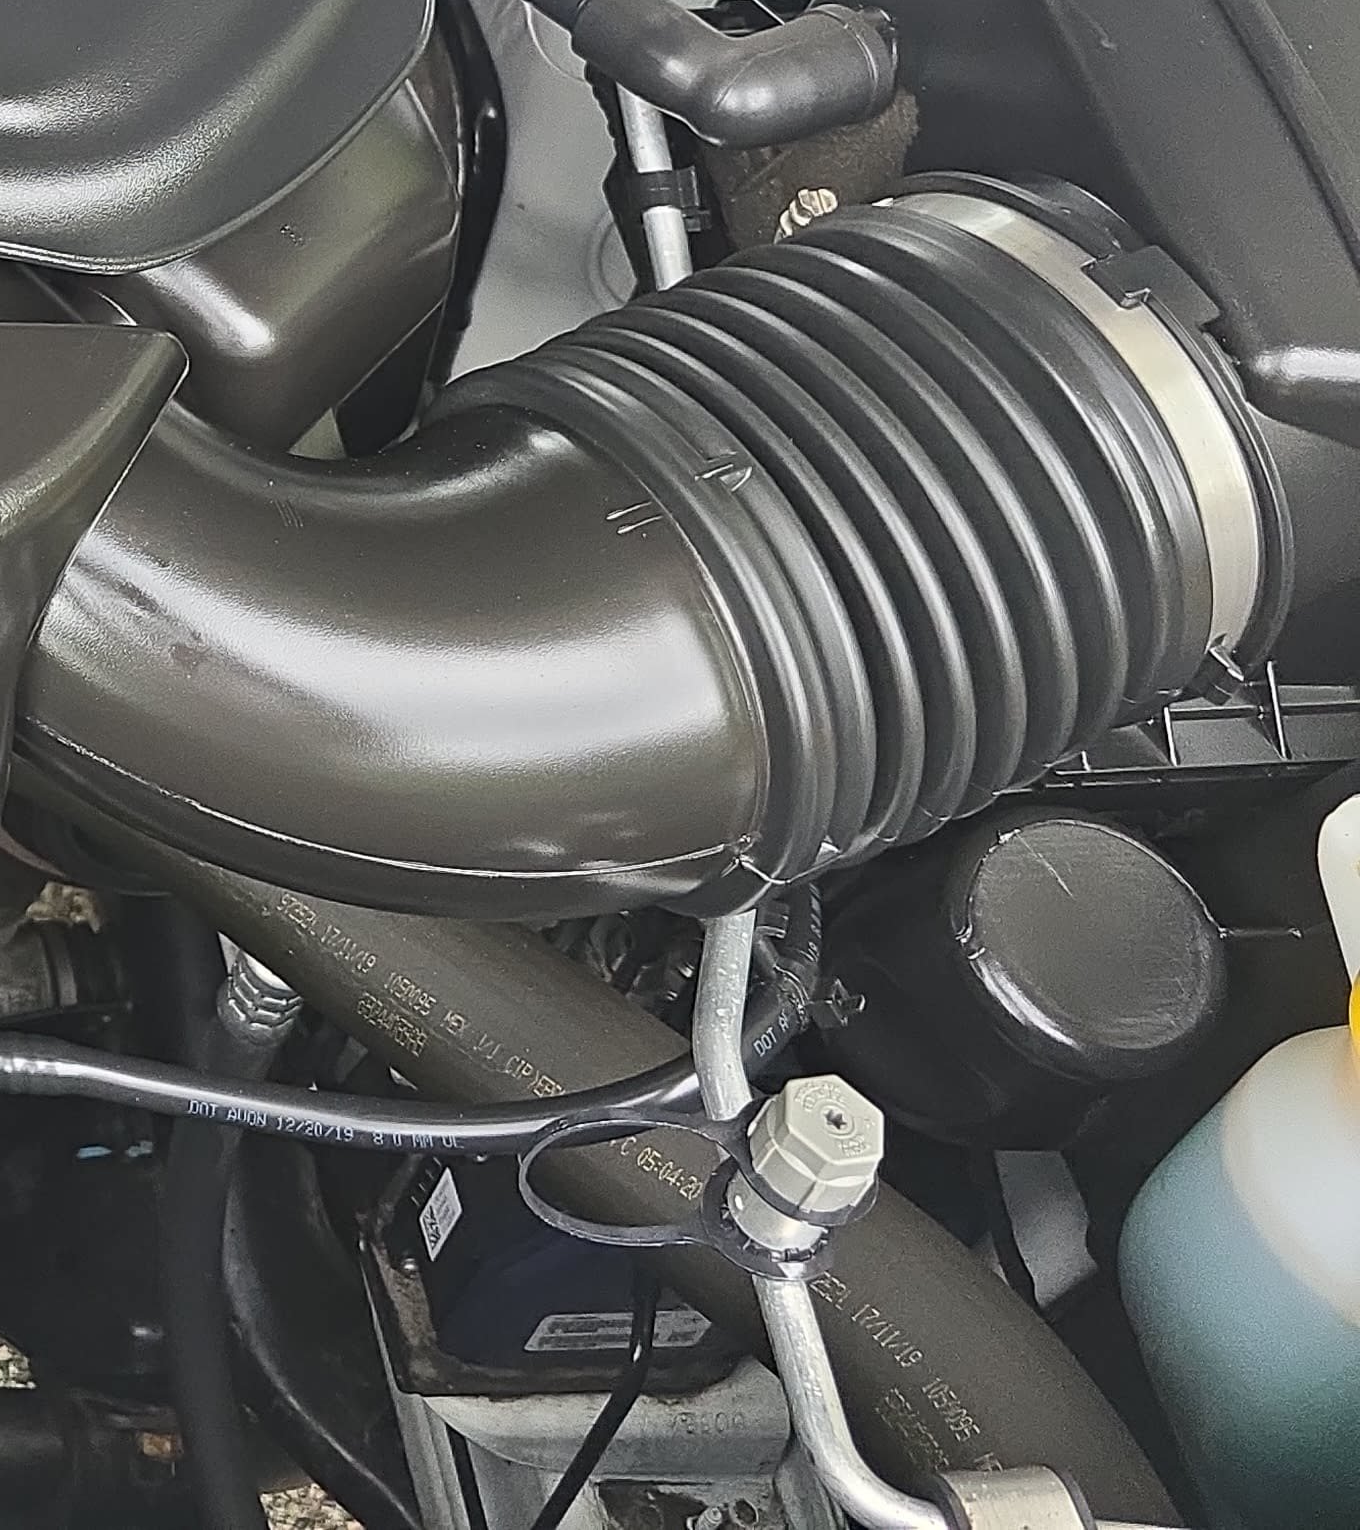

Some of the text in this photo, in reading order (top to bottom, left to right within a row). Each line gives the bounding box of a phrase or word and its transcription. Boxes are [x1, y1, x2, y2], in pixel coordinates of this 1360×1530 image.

[753, 1027, 778, 1057] DOT
[275, 1116, 356, 1143] 12/20/19
[636, 1146, 704, 1201] 05:04:20
